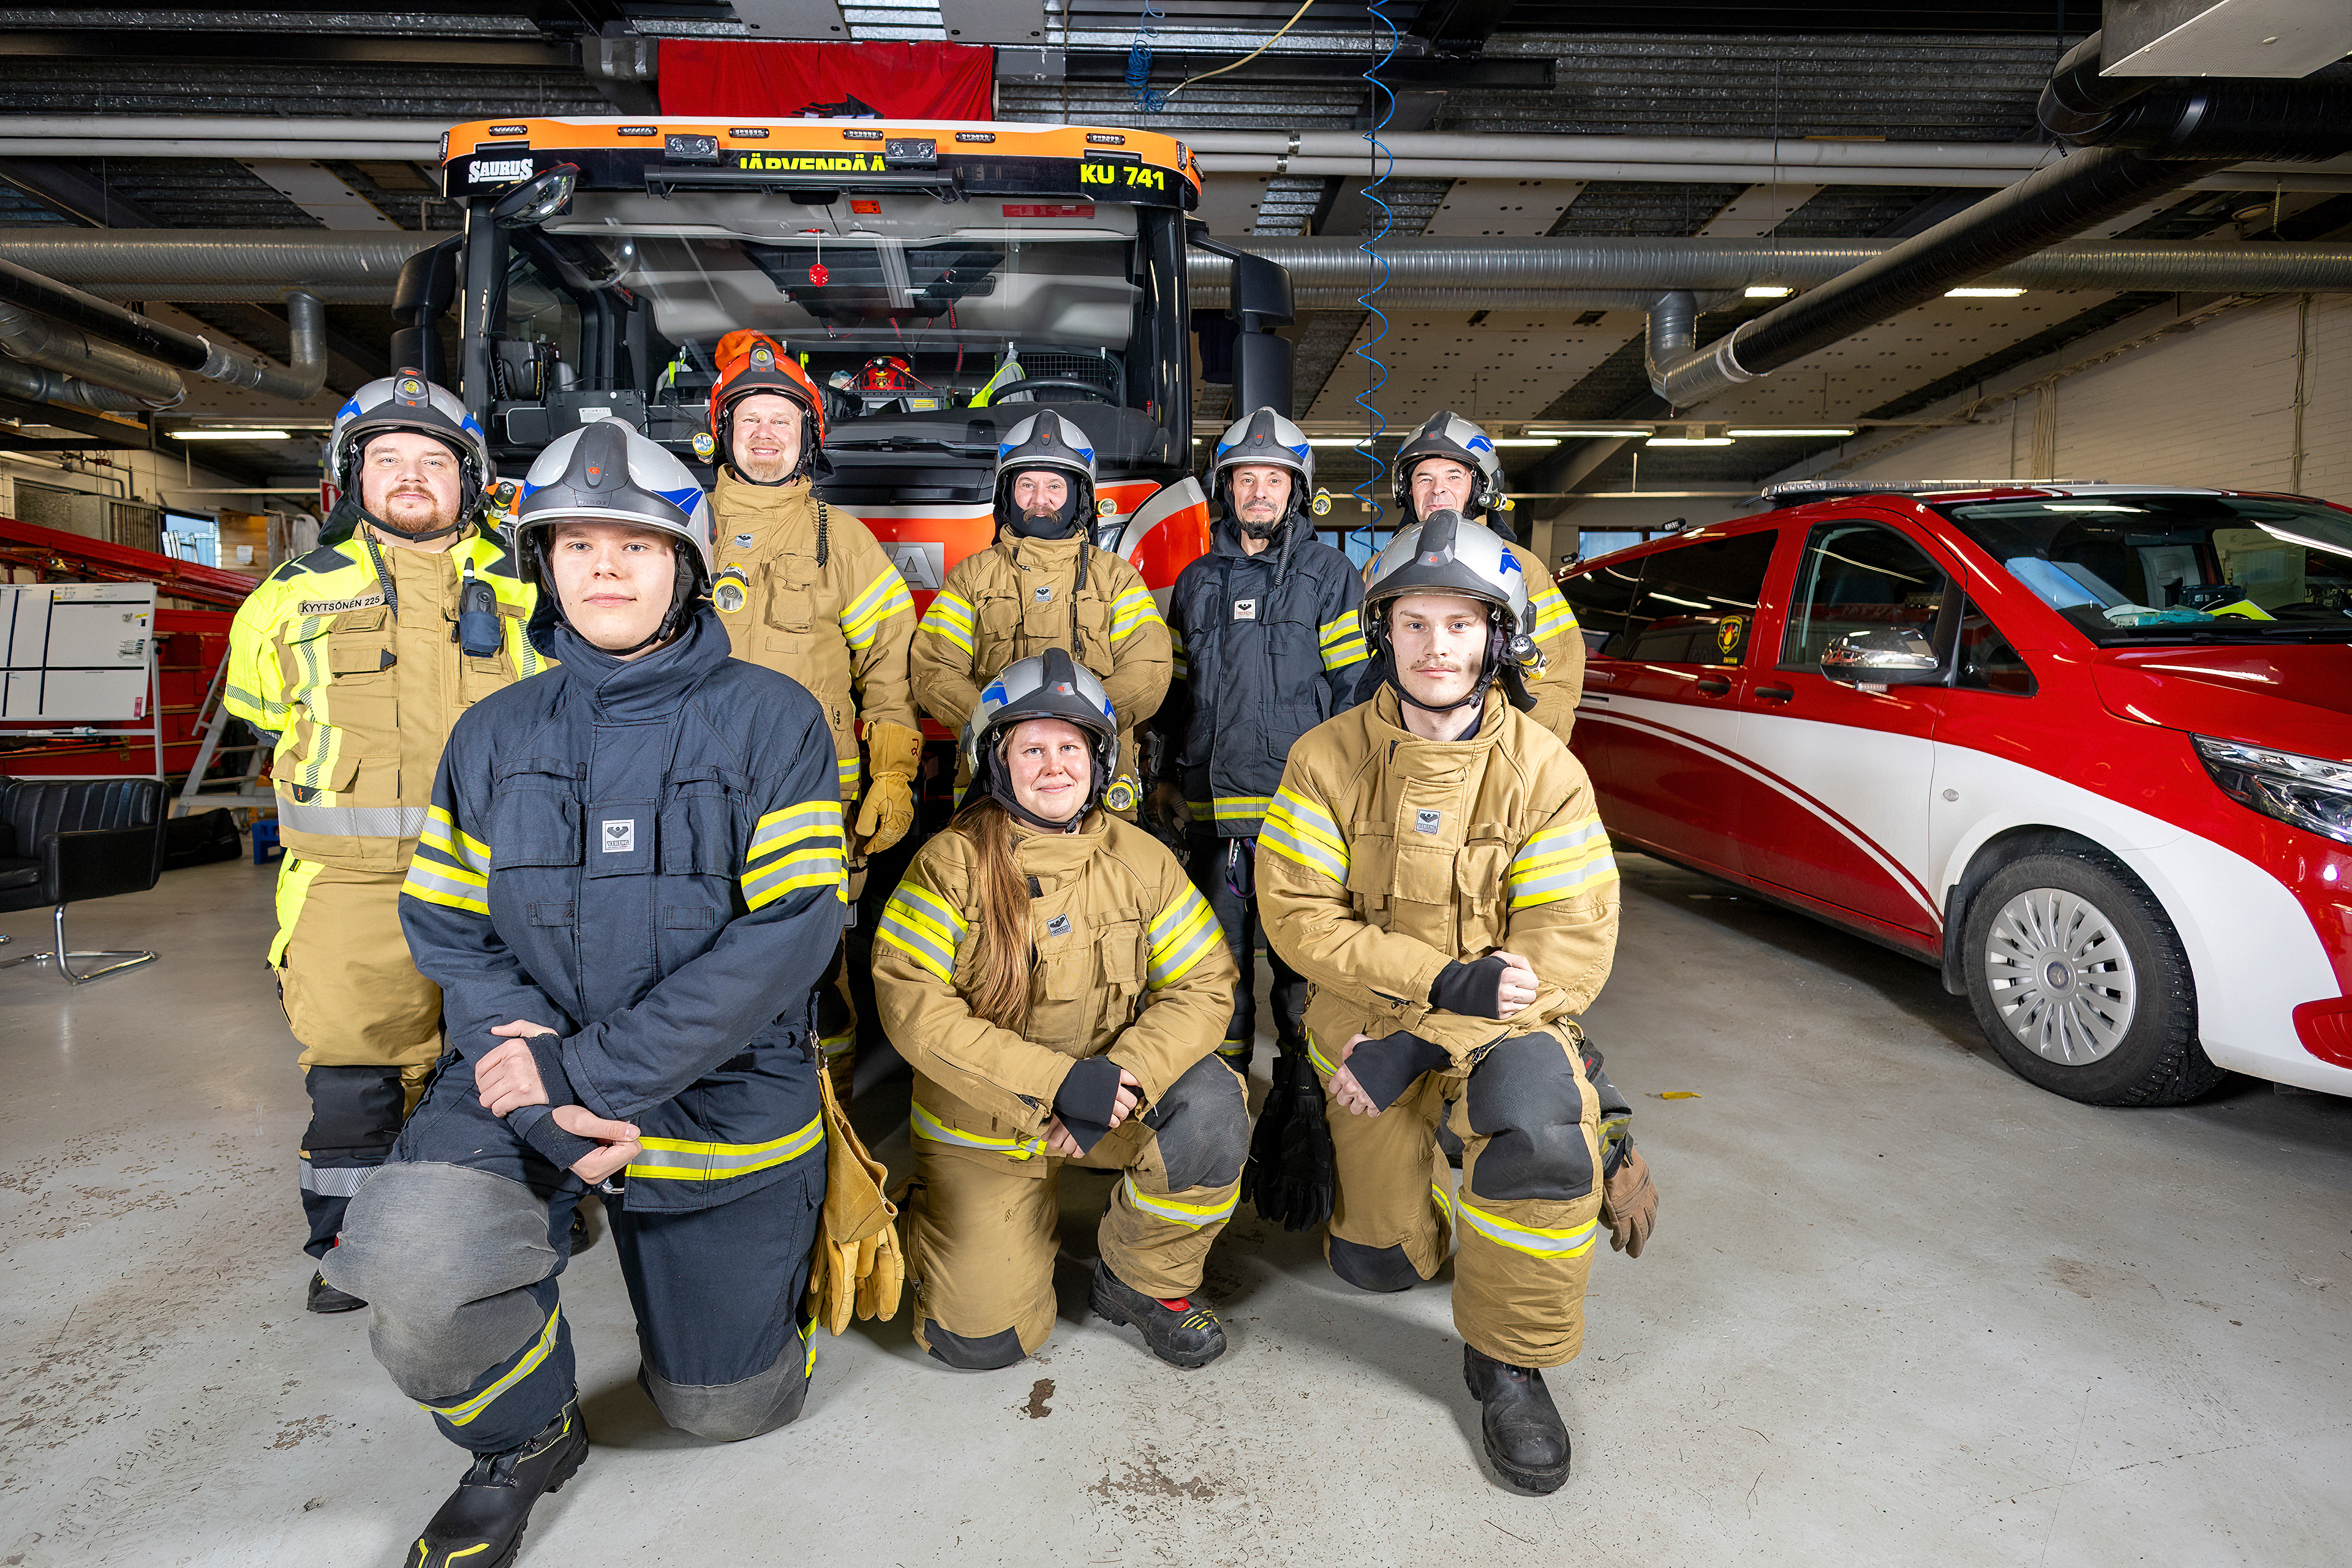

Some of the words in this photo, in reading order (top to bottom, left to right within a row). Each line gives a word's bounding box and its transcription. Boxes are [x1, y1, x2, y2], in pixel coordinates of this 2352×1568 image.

[469, 158, 533, 183] SAURUS
[1080, 164, 1115, 184] KU
[1123, 166, 1164, 190] 741
[364, 596, 380, 606] 225
